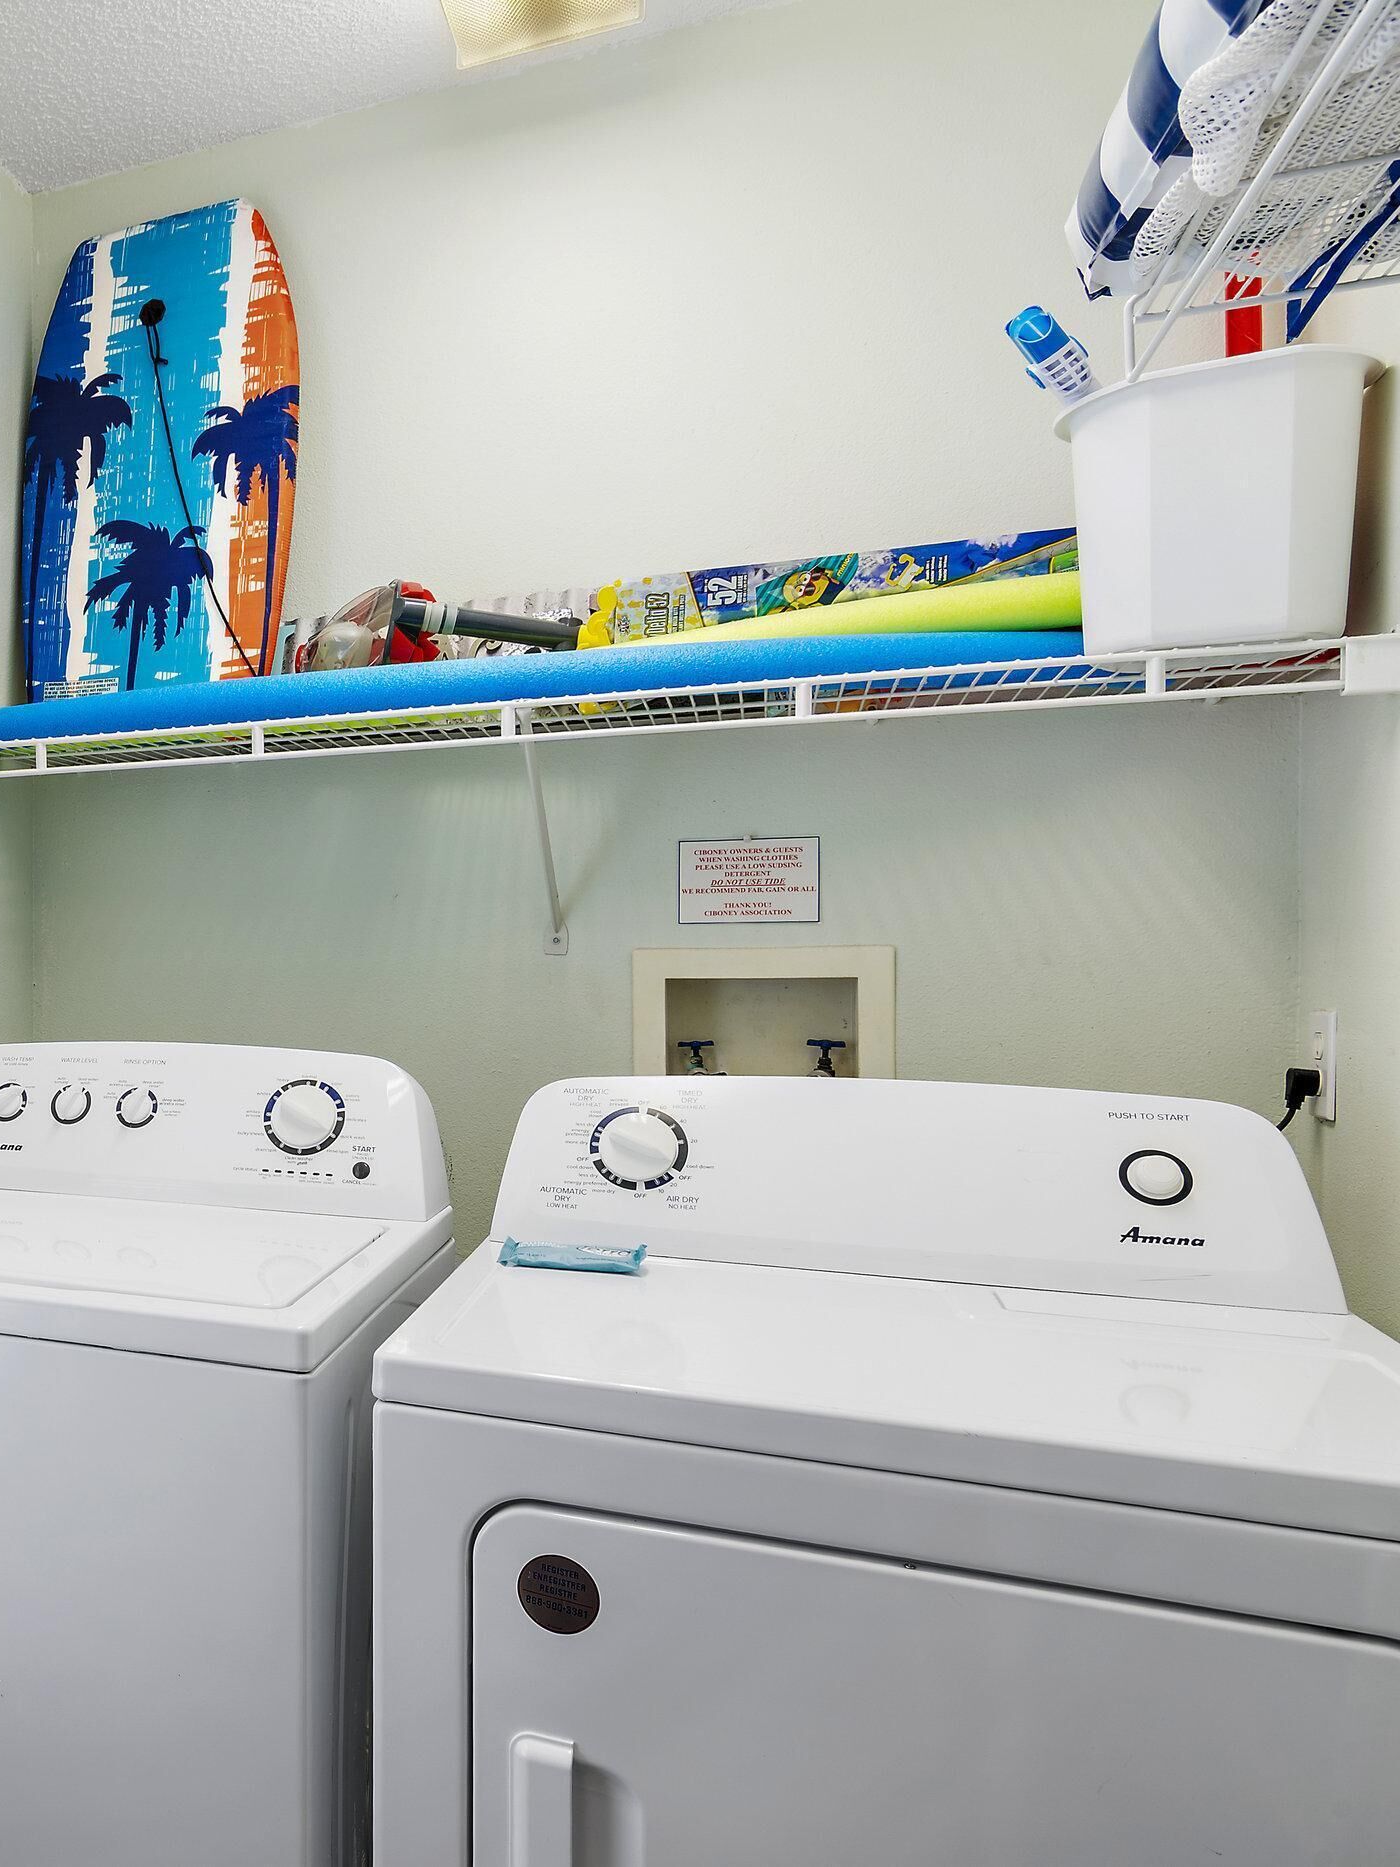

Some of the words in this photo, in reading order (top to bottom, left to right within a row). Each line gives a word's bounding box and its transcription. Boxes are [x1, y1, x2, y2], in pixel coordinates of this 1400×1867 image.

[707, 576, 737, 607] 52
[645, 593, 669, 608] 52
[765, 878, 786, 886] TIDE
[1157, 1113, 1190, 1121] START
[540, 1186, 587, 1195] AUTOMATIC
[1120, 1226, 1205, 1247] Amana
[541, 1563, 579, 1580] REGISTER
[533, 1572, 586, 1592] ENREGISTRER
[540, 1584, 578, 1600] REGISTRE
